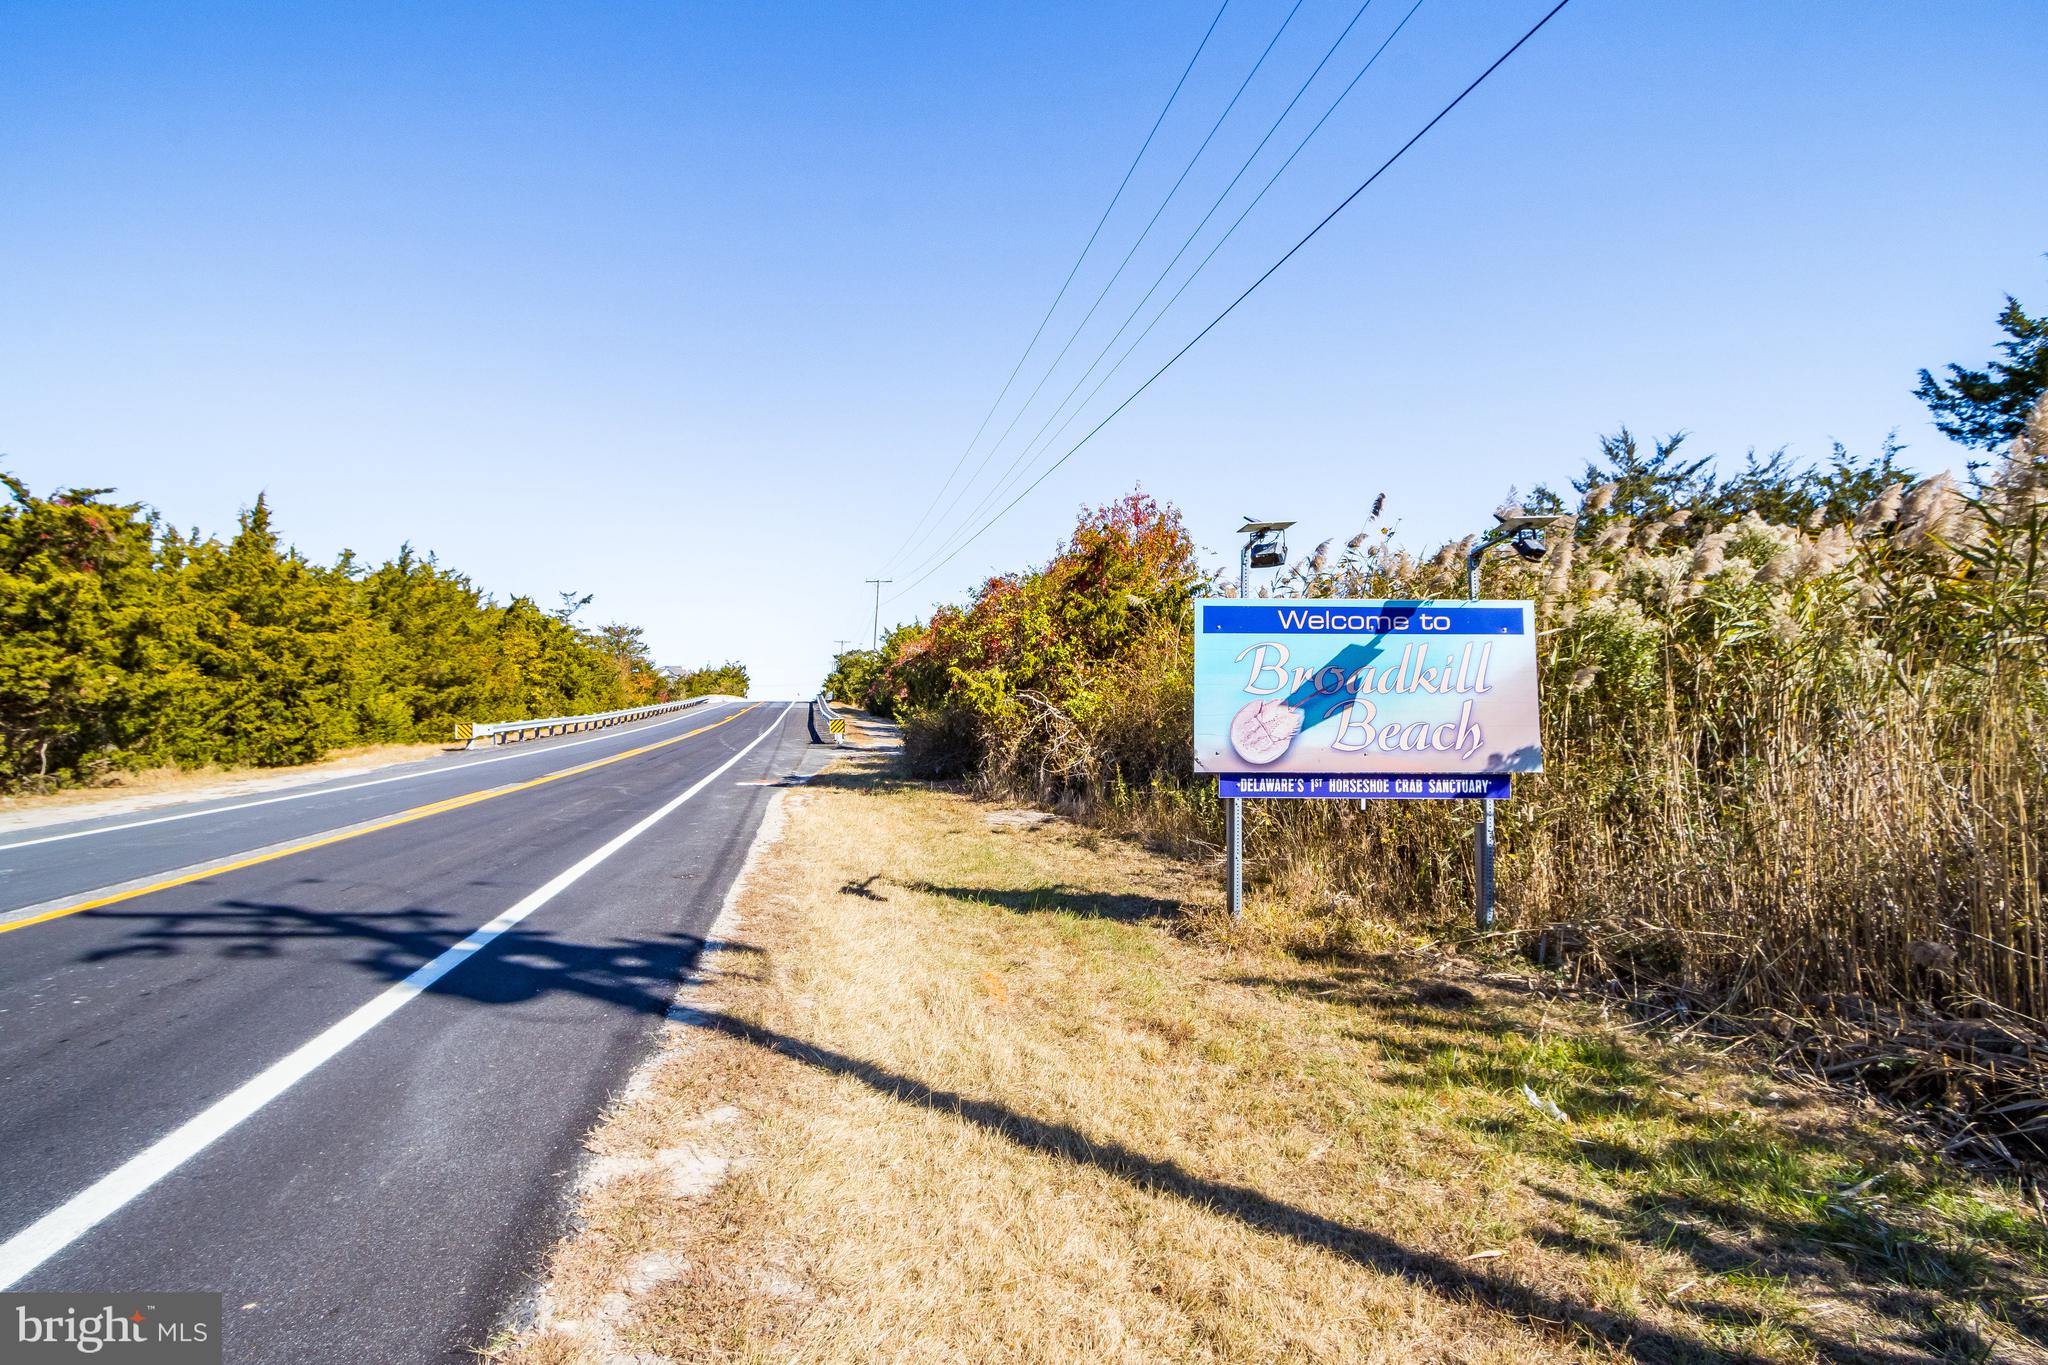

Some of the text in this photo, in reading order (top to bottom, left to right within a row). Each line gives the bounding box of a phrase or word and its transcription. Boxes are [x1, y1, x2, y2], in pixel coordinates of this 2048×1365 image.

[1278, 609, 1451, 630] Welcome to
[1234, 641, 1493, 695] Broadkill
[1323, 698, 1484, 760] Beach
[1240, 778, 1489, 793] DELAWARE'S 1ST HORSESHOE CRAB SANCTUARY
